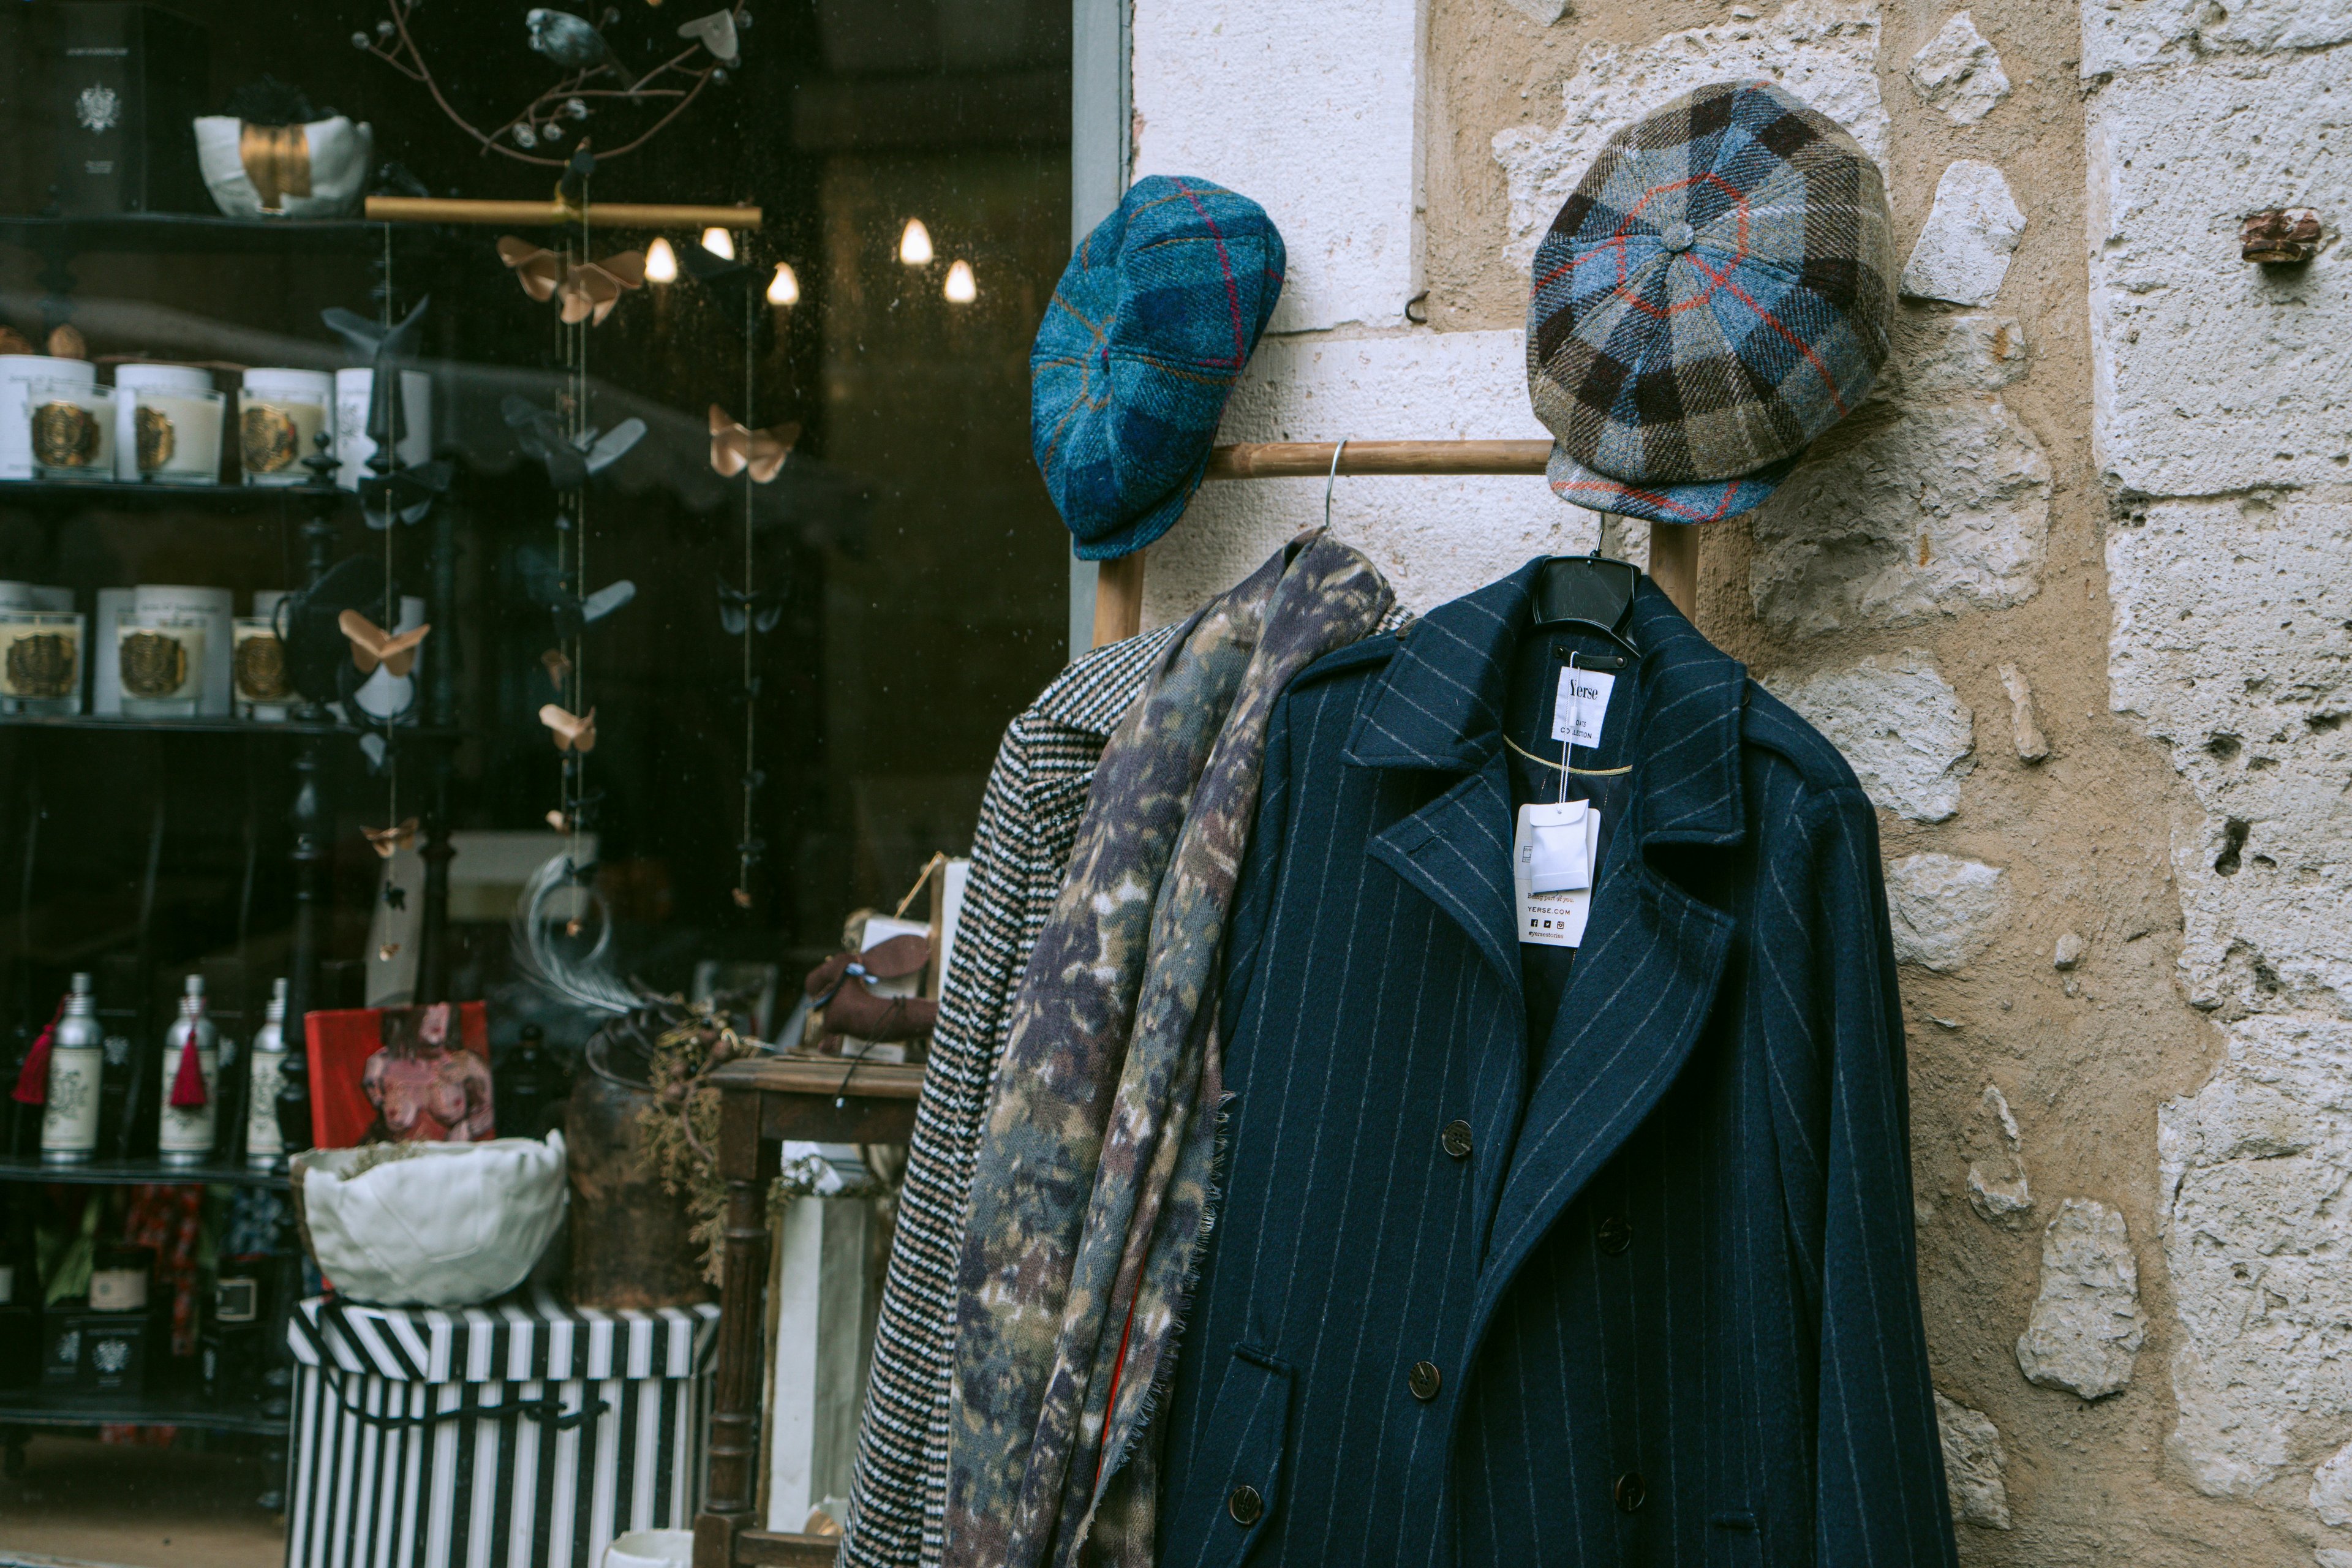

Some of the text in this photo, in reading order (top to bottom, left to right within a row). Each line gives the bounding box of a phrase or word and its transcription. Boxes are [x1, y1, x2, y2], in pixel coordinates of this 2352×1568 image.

[1570, 679, 1598, 700] Yerse
[1560, 727, 1592, 739] COLECTION
[1528, 907, 1570, 915] YERSE.COM
